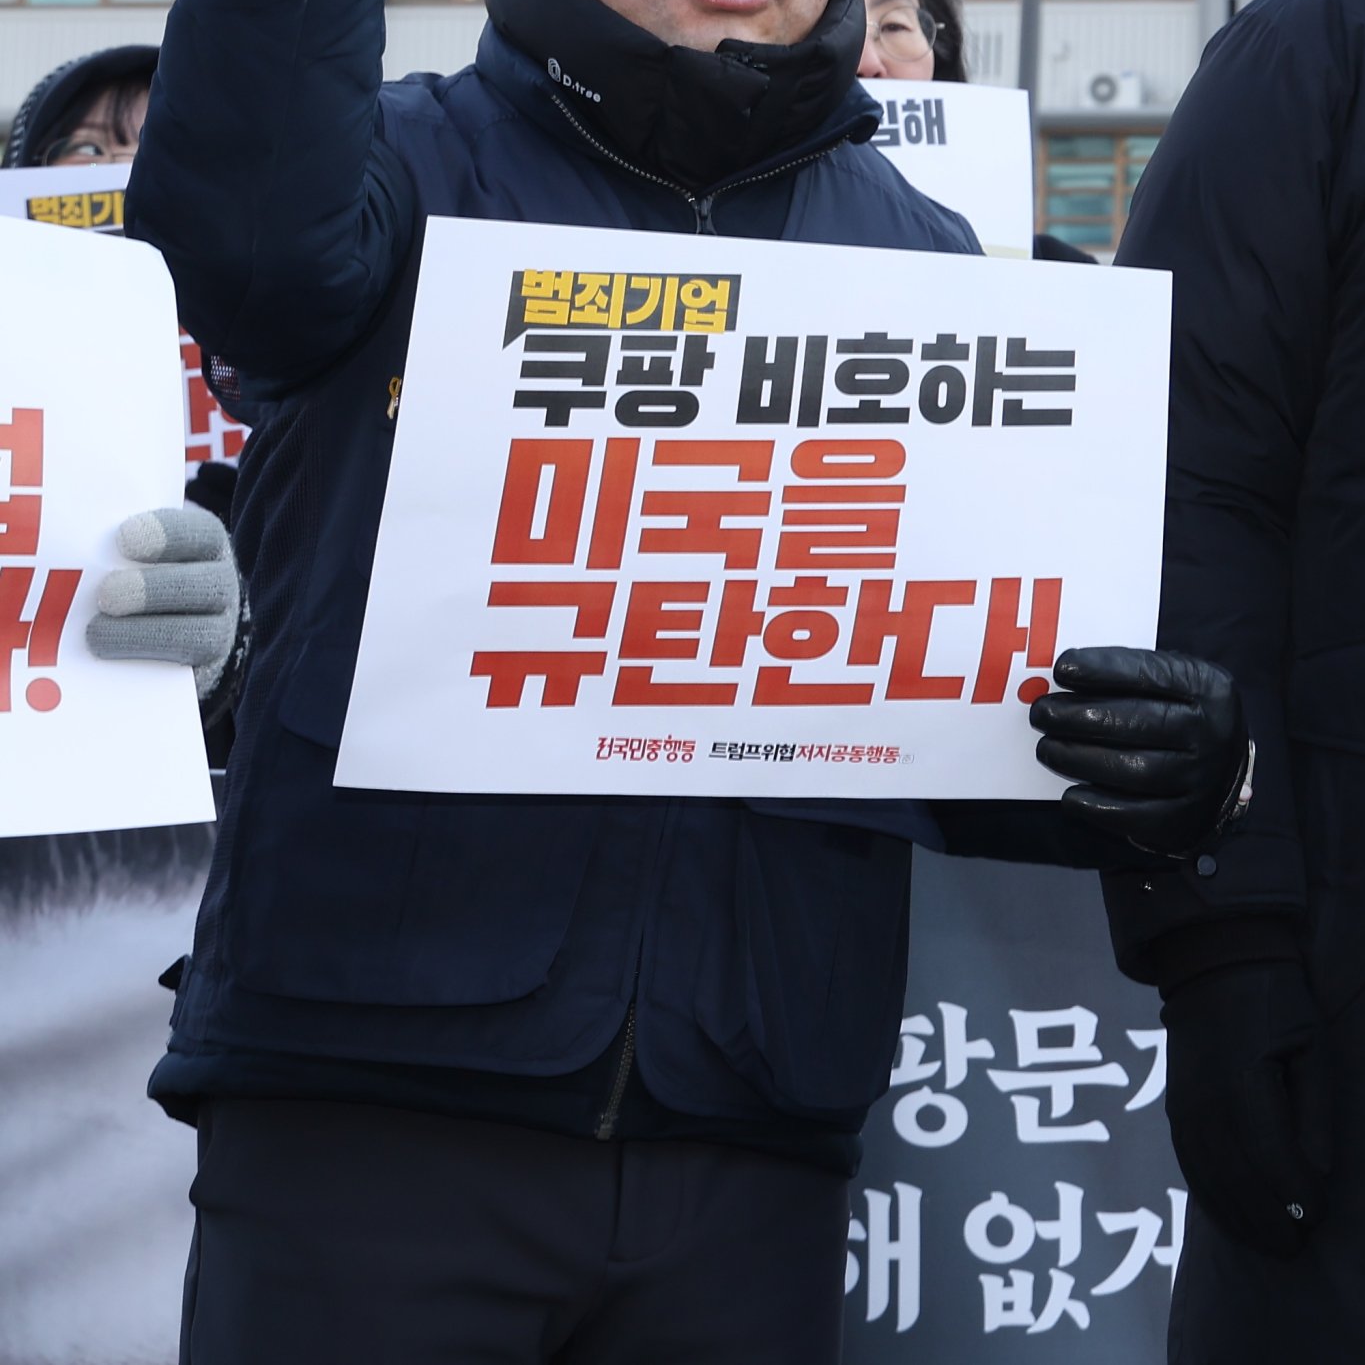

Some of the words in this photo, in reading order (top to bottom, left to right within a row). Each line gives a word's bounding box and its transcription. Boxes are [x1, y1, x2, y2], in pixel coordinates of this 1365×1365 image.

[562, 75, 601, 103] D.tree
[521, 269, 731, 334] 범죄기업
[513, 332, 714, 427] 쿠팡
[735, 332, 1077, 427] 비호하는
[491, 437, 907, 570] 미국을
[470, 577, 1063, 709] 규탄한다!
[596, 734, 696, 763] 전국민중행동
